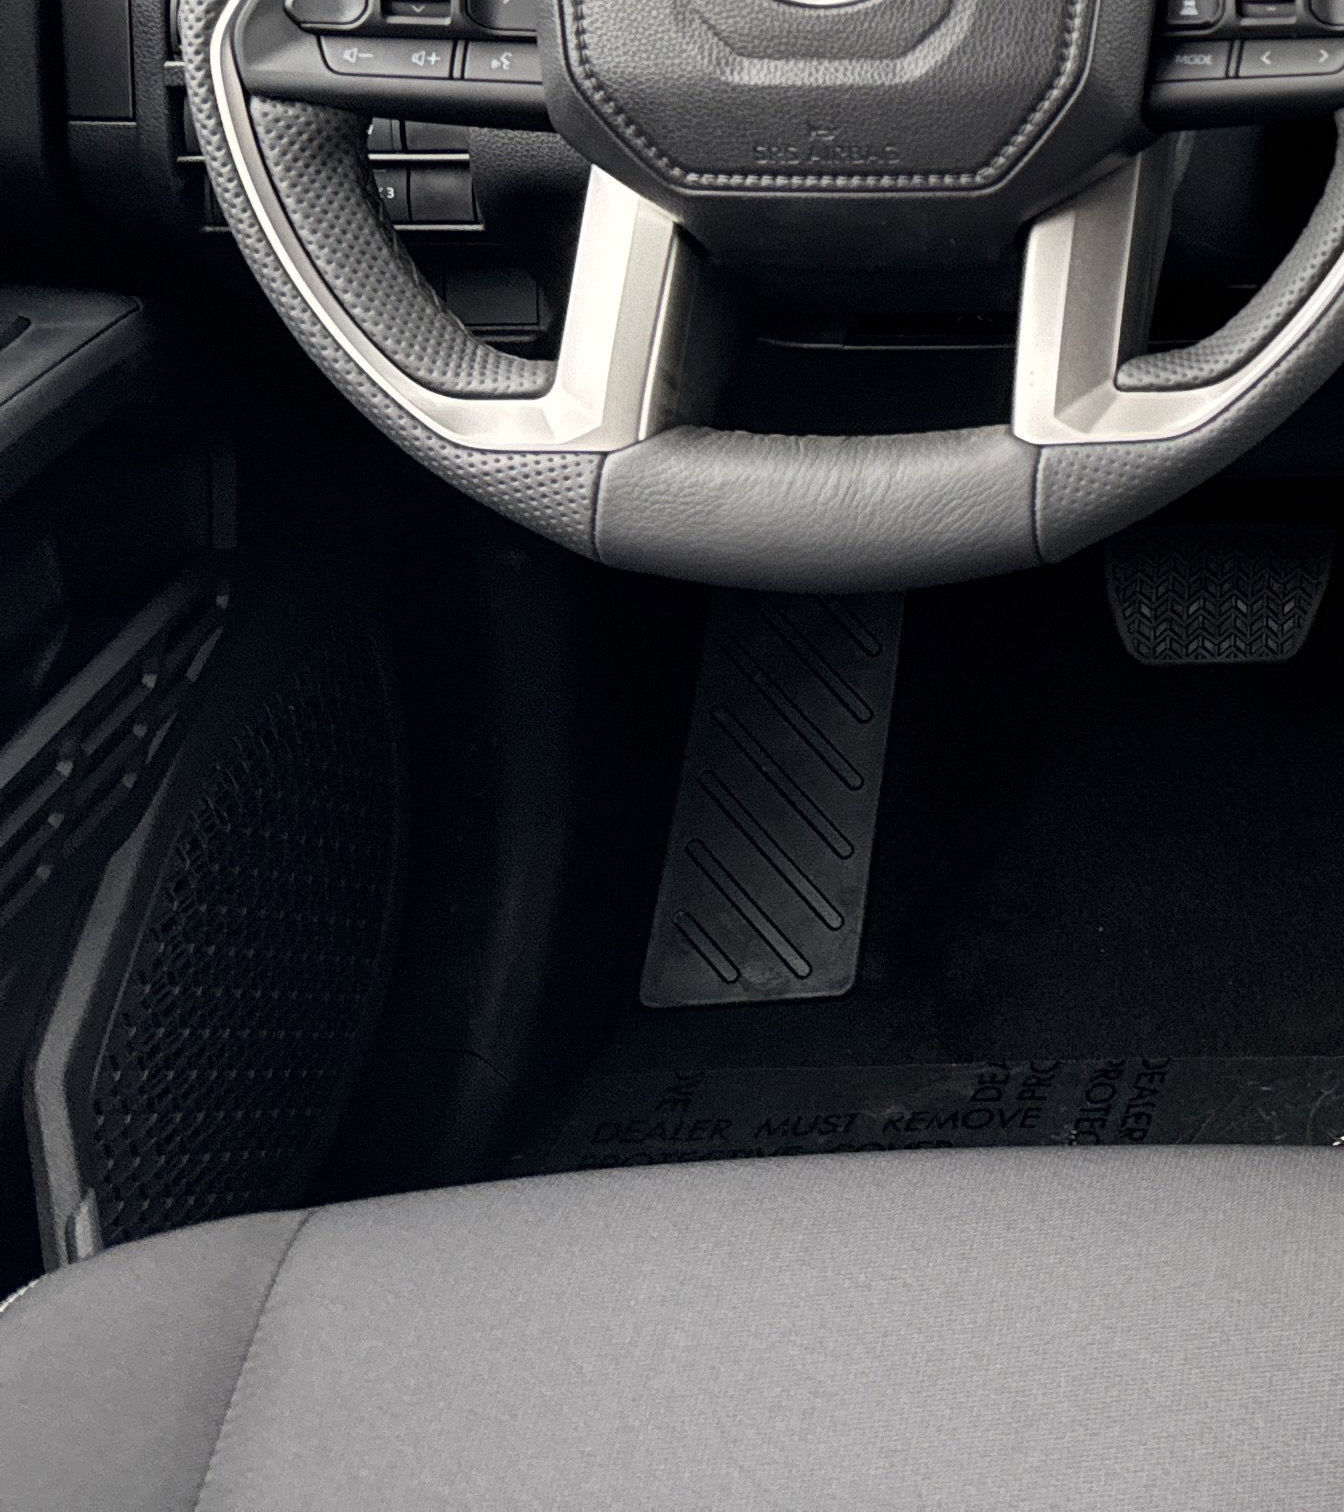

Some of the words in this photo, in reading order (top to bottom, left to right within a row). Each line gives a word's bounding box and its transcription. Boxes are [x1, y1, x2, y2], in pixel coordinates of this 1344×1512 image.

[1175, 54, 1214, 65] MODE
[590, 1119, 734, 1146] DEALER
[754, 1112, 862, 1138] MUST
[882, 1105, 1041, 1133] REMOVE
